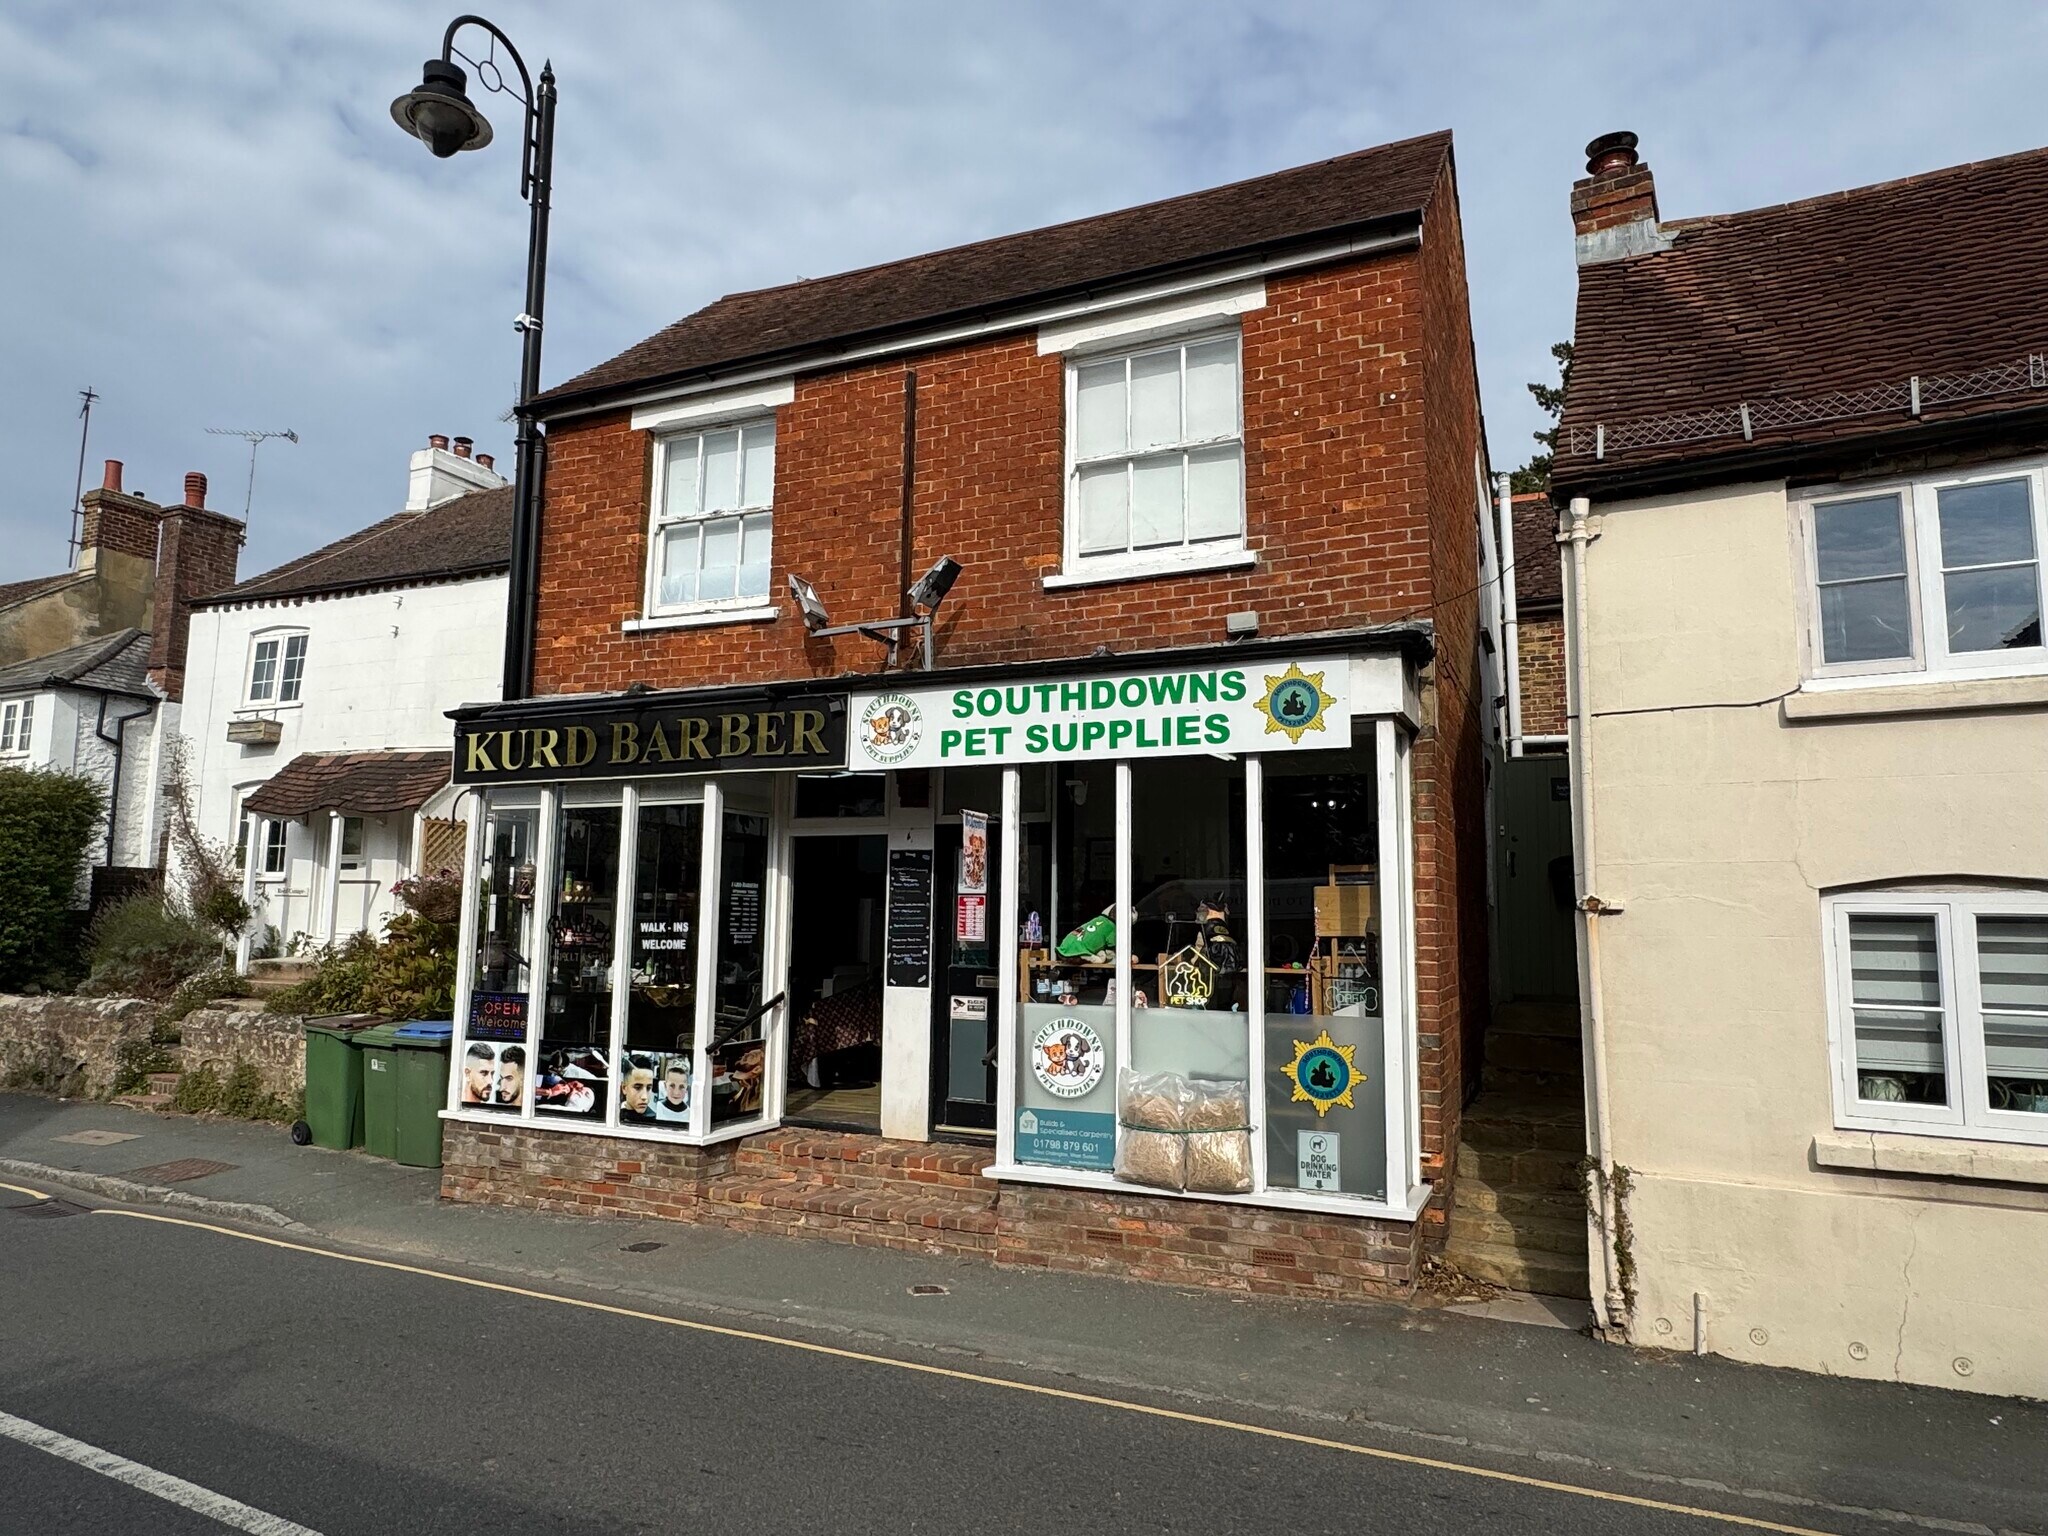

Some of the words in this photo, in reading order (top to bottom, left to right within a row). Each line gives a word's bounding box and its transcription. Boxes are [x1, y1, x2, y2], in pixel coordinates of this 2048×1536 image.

[952, 670, 1247, 719] SOUTHDOWNS
[862, 694, 921, 725] SOUTHDOWNS
[464, 725, 598, 772] KURD
[607, 709, 830, 764] BARBER
[941, 726, 1012, 757] PET
[1025, 713, 1231, 754] SUPPLIES
[866, 745, 880, 759] PET
[640, 922, 667, 933] WALK
[673, 922, 689, 933] INS
[641, 939, 687, 950] WELCOME
[1170, 996, 1185, 1005] PET
[1186, 997, 1208, 1006] SHOP
[1336, 993, 1367, 1004] OPEN
[484, 1001, 521, 1015] OPEN
[476, 1015, 527, 1030] Welcome
[1034, 1019, 1103, 1053] SOUTHDOWNS
[1039, 1073, 1056, 1090] PET
[1055, 1076, 1096, 1097] SUPPLIES
[1022, 1119, 1035, 1130] JT
[1039, 1119, 1059, 1128] Builds
[1039, 1128, 1078, 1137] Specialised
[1079, 1130, 1114, 1140] Carpentry
[1033, 1138, 1061, 1151] 01798
[1063, 1140, 1081, 1152] 879
[1082, 1142, 1099, 1153] 601
[1311, 1154, 1327, 1164] DOG
[1300, 1161, 1337, 1172] DRINKING
[1306, 1170, 1332, 1180] WATER
